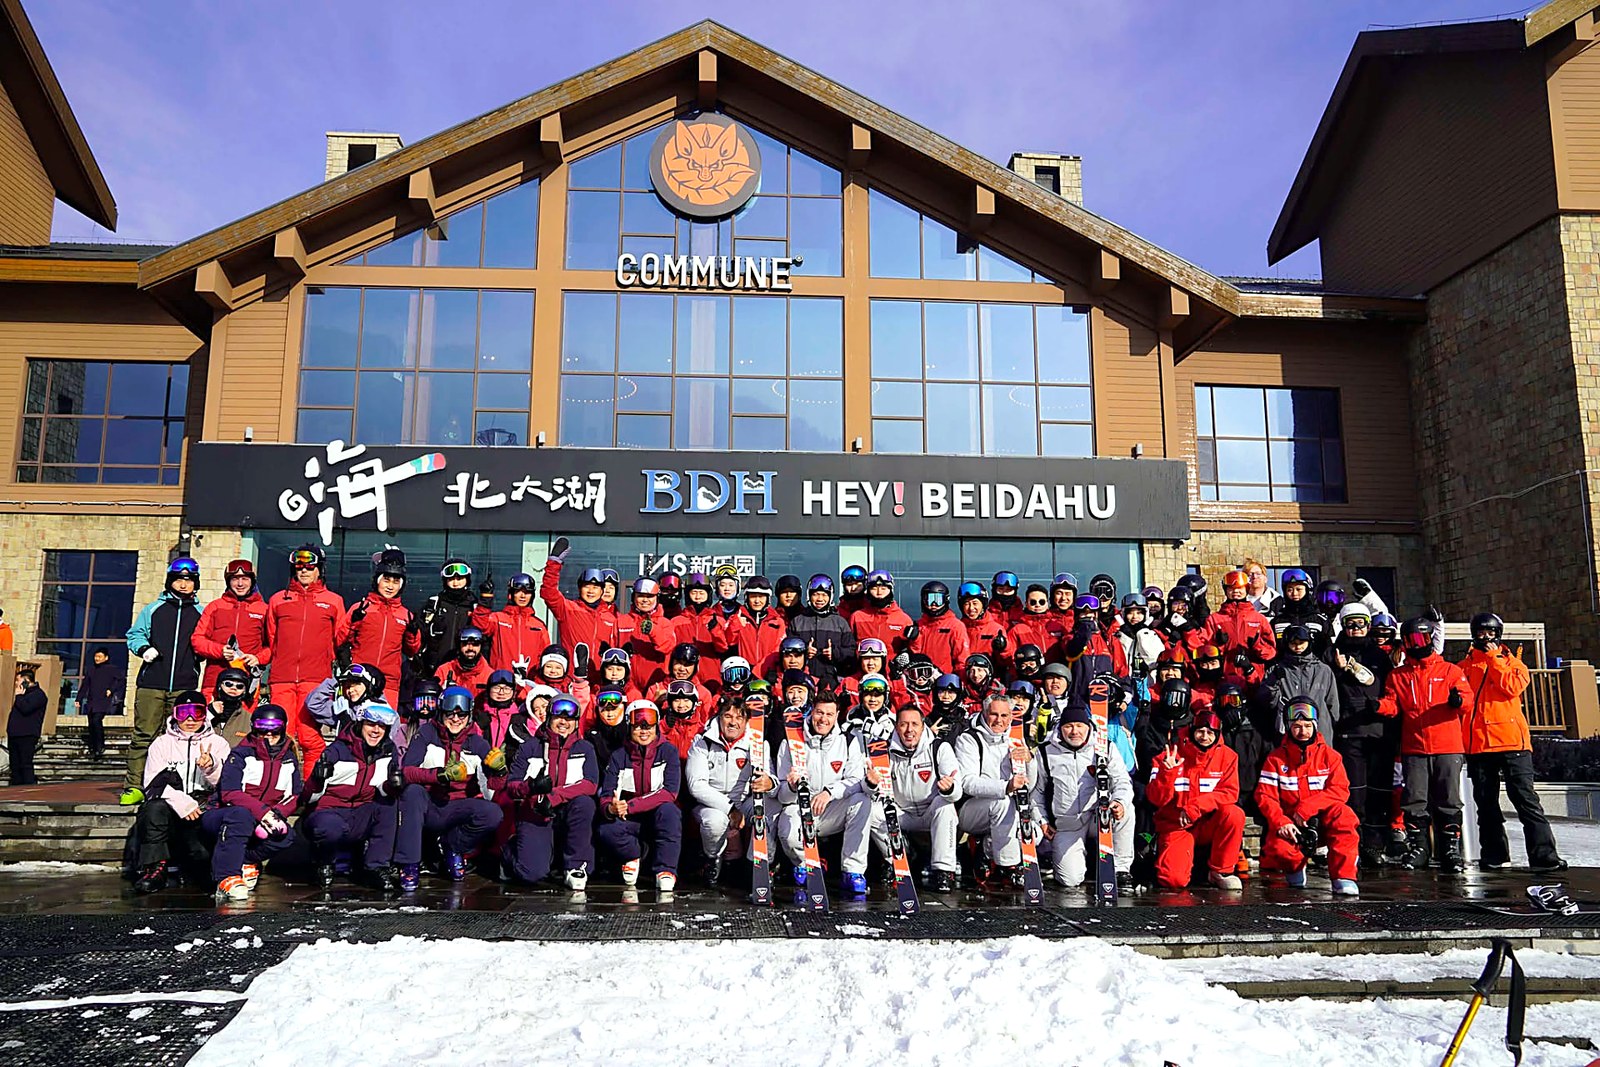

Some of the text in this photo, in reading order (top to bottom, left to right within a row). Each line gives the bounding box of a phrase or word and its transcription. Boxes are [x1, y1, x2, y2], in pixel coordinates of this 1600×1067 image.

[617, 253, 793, 290] COMMUNE
[640, 469, 779, 514] BDH
[802, 480, 1117, 520] HEY! BEIDAHU
